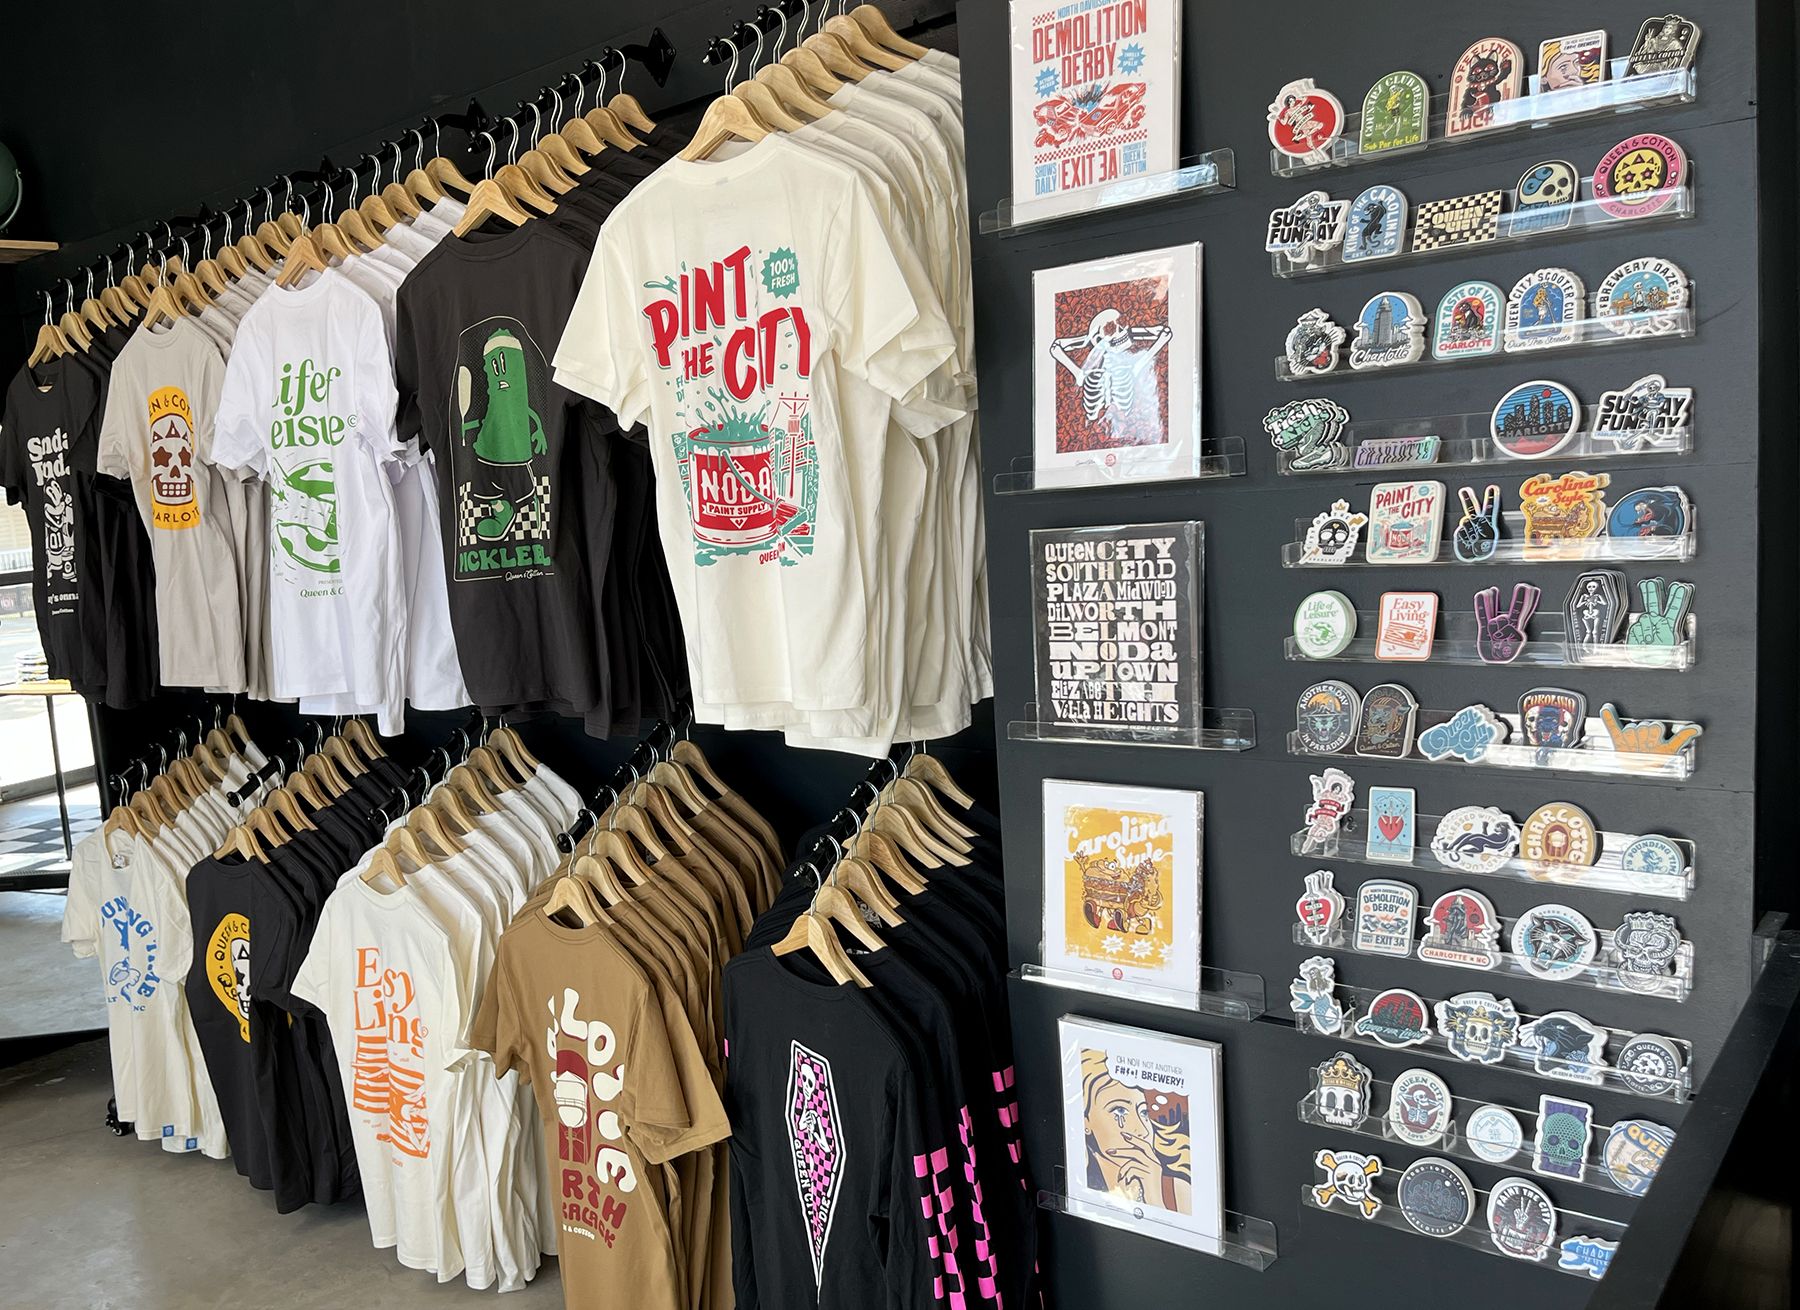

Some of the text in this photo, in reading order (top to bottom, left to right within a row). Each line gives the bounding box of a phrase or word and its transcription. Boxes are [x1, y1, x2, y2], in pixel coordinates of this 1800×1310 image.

[1033, 0, 1147, 64] DEMOLITION
[1061, 43, 1117, 88] DERBY
[1365, 84, 1383, 137] COUNTRY
[1385, 74, 1416, 89] CLUB
[1411, 85, 1422, 128] REJECT
[1450, 110, 1508, 133] LUCK
[1405, 134, 1420, 145] Life
[1599, 143, 1630, 175] QUEEN
[1641, 136, 1678, 162] COTTON
[1035, 162, 1057, 179] SHOWS
[1061, 148, 1118, 190] EXIT 3A
[1035, 174, 1057, 195] DAILY
[1271, 206, 1343, 228] SUNAY
[1345, 226, 1359, 253] KING
[1353, 196, 1367, 213] THE
[1369, 188, 1400, 247] CAROLINAS
[769, 257, 795, 277] 100%
[771, 274, 796, 290] FRESH
[1467, 286, 1483, 297] OF
[1513, 276, 1533, 299] CITY
[1538, 272, 1576, 300] SCOOTER
[1599, 261, 1649, 305] BREWERY
[1653, 263, 1679, 288] DAZE
[1442, 290, 1467, 319] TASTE
[1564, 302, 1575, 324] CLU
[1509, 303, 1519, 333] UEEN
[1440, 322, 1451, 343] THE
[1352, 343, 1410, 365] Charlotte
[1438, 339, 1493, 352] CHARLOTTE
[1601, 395, 1686, 414] SUNAY
[1499, 422, 1570, 439] CHARLOTTE
[701, 467, 771, 505] NODA
[1524, 474, 1598, 497] Carolina
[1375, 485, 1415, 509] PAINT
[1388, 496, 1436, 519] THE CITY
[1553, 491, 1590, 506] Style
[708, 502, 767, 516] PAINT SUPPLY
[1046, 561, 1115, 582] SOUTH
[300, 587, 329, 598] Queen
[1046, 581, 1116, 602] PLAZA
[1303, 609, 1337, 620] Leisure
[1307, 601, 1324, 611] Life
[1392, 597, 1425, 611] Easy
[1389, 609, 1427, 624] Living
[1048, 620, 1178, 642] BELMONT
[1300, 685, 1335, 710] ANOTHER
[1335, 688, 1349, 707] DAY
[1093, 700, 1180, 724] HEIGHTS
[1308, 732, 1348, 752] PARADISE
[1064, 815, 1173, 862] Carolina
[1527, 808, 1589, 864] CHARLOTTE
[1627, 841, 1672, 858] POUNDING
[1363, 893, 1410, 907] DEMOLITION
[1372, 903, 1400, 913] DERBY
[1375, 935, 1405, 947] EXIT 3A
[1423, 949, 1487, 964] CHARLOTTE NC
[1116, 1055, 1126, 1064] OH
[1142, 1060, 1154, 1070] NOT
[1155, 1063, 1183, 1075] ANOTHER
[1636, 1044, 1673, 1078] QUEEN COTTO
[1141, 1070, 1185, 1089] BREWERY!
[1398, 1076, 1428, 1093] QUEEN
[1627, 1125, 1668, 1159] QUEE
[794, 1138, 811, 1189] QUEEN
[1496, 1186, 1550, 1225] PAINT THE CITY
